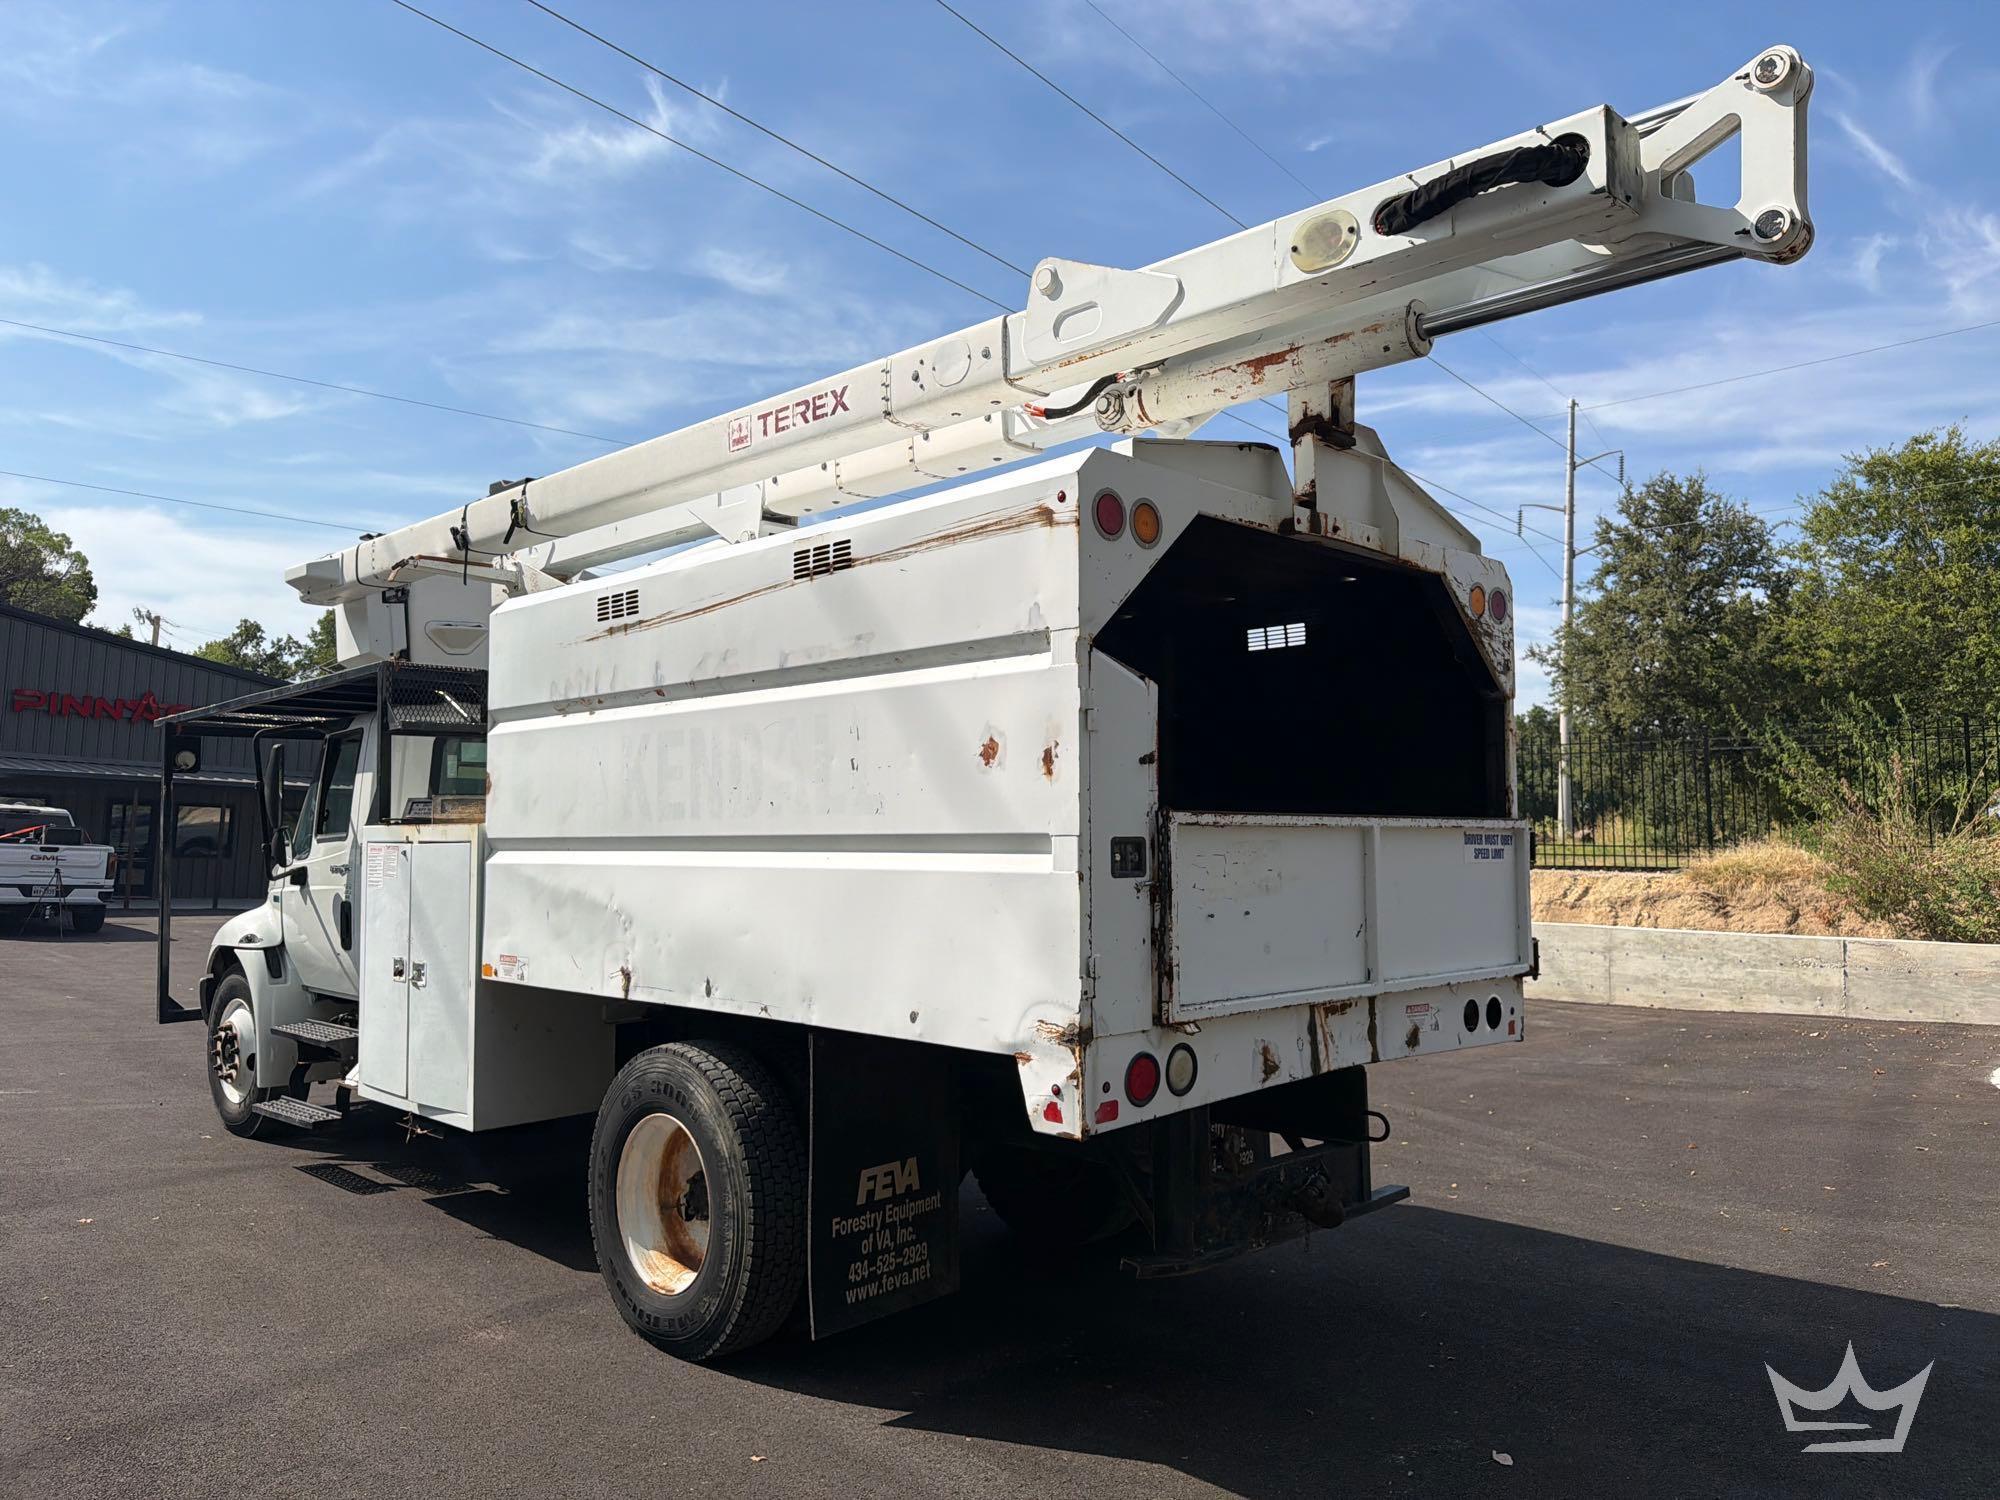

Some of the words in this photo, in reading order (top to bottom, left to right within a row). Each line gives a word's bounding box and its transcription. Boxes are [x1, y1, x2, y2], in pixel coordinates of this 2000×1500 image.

[757, 385, 850, 438] TEREX
[1464, 833, 1483, 846] DRIVER
[1485, 834, 1499, 846] MUST
[1500, 834, 1513, 846] OBEY
[1474, 847, 1490, 860] SPEED
[1491, 848, 1505, 860] LIMIT
[856, 1156, 921, 1206] FEVA
[832, 1209, 882, 1238] Forestry
[885, 1191, 942, 1224] Equipment
[861, 1232, 874, 1255] of
[876, 1229, 894, 1251] VA,
[896, 1226, 917, 1245] Inc.
[848, 1242, 928, 1283] 434-525-2929
[846, 1263, 931, 1304] www.feva.net
